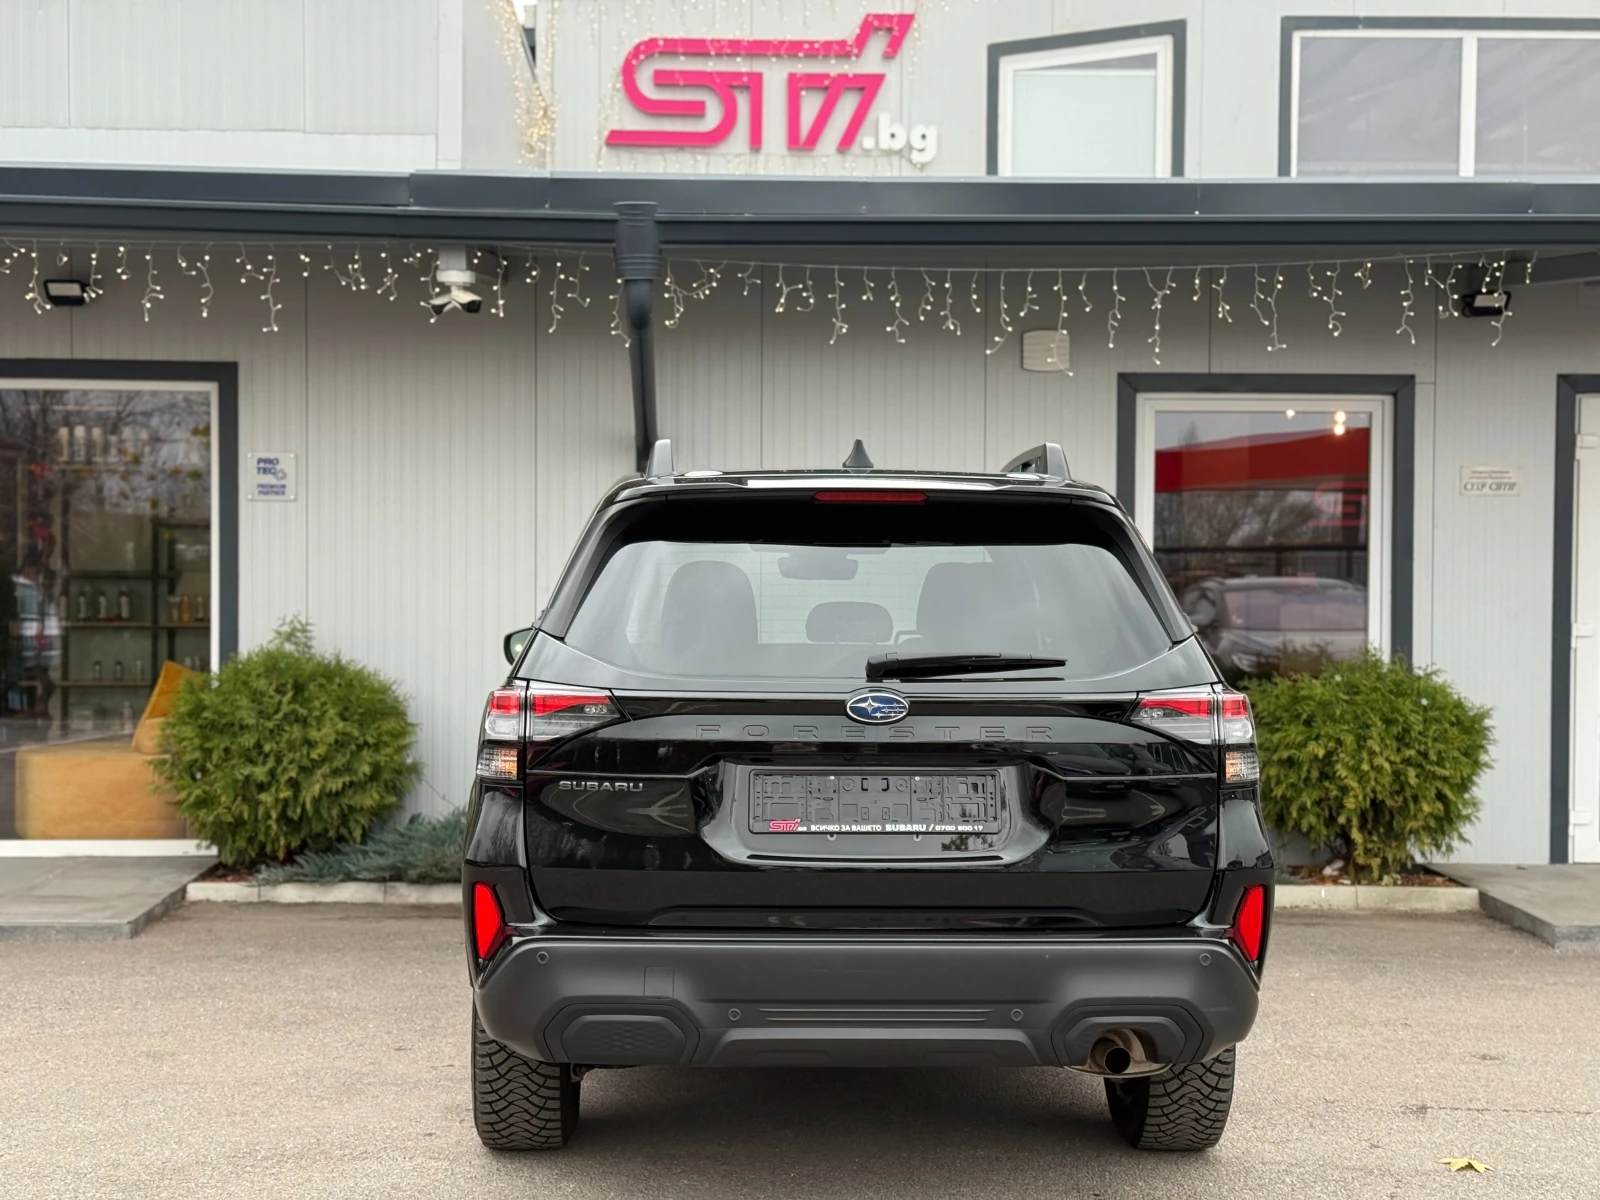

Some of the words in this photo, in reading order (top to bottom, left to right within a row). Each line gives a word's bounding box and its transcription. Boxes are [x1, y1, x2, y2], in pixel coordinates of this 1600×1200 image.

[256, 457, 280, 466] PRO
[695, 724, 1053, 741] FORESTER
[559, 781, 643, 792] SUBARU
[811, 824, 839, 832] ВСИЧКО
[885, 824, 926, 832] SUBARU
